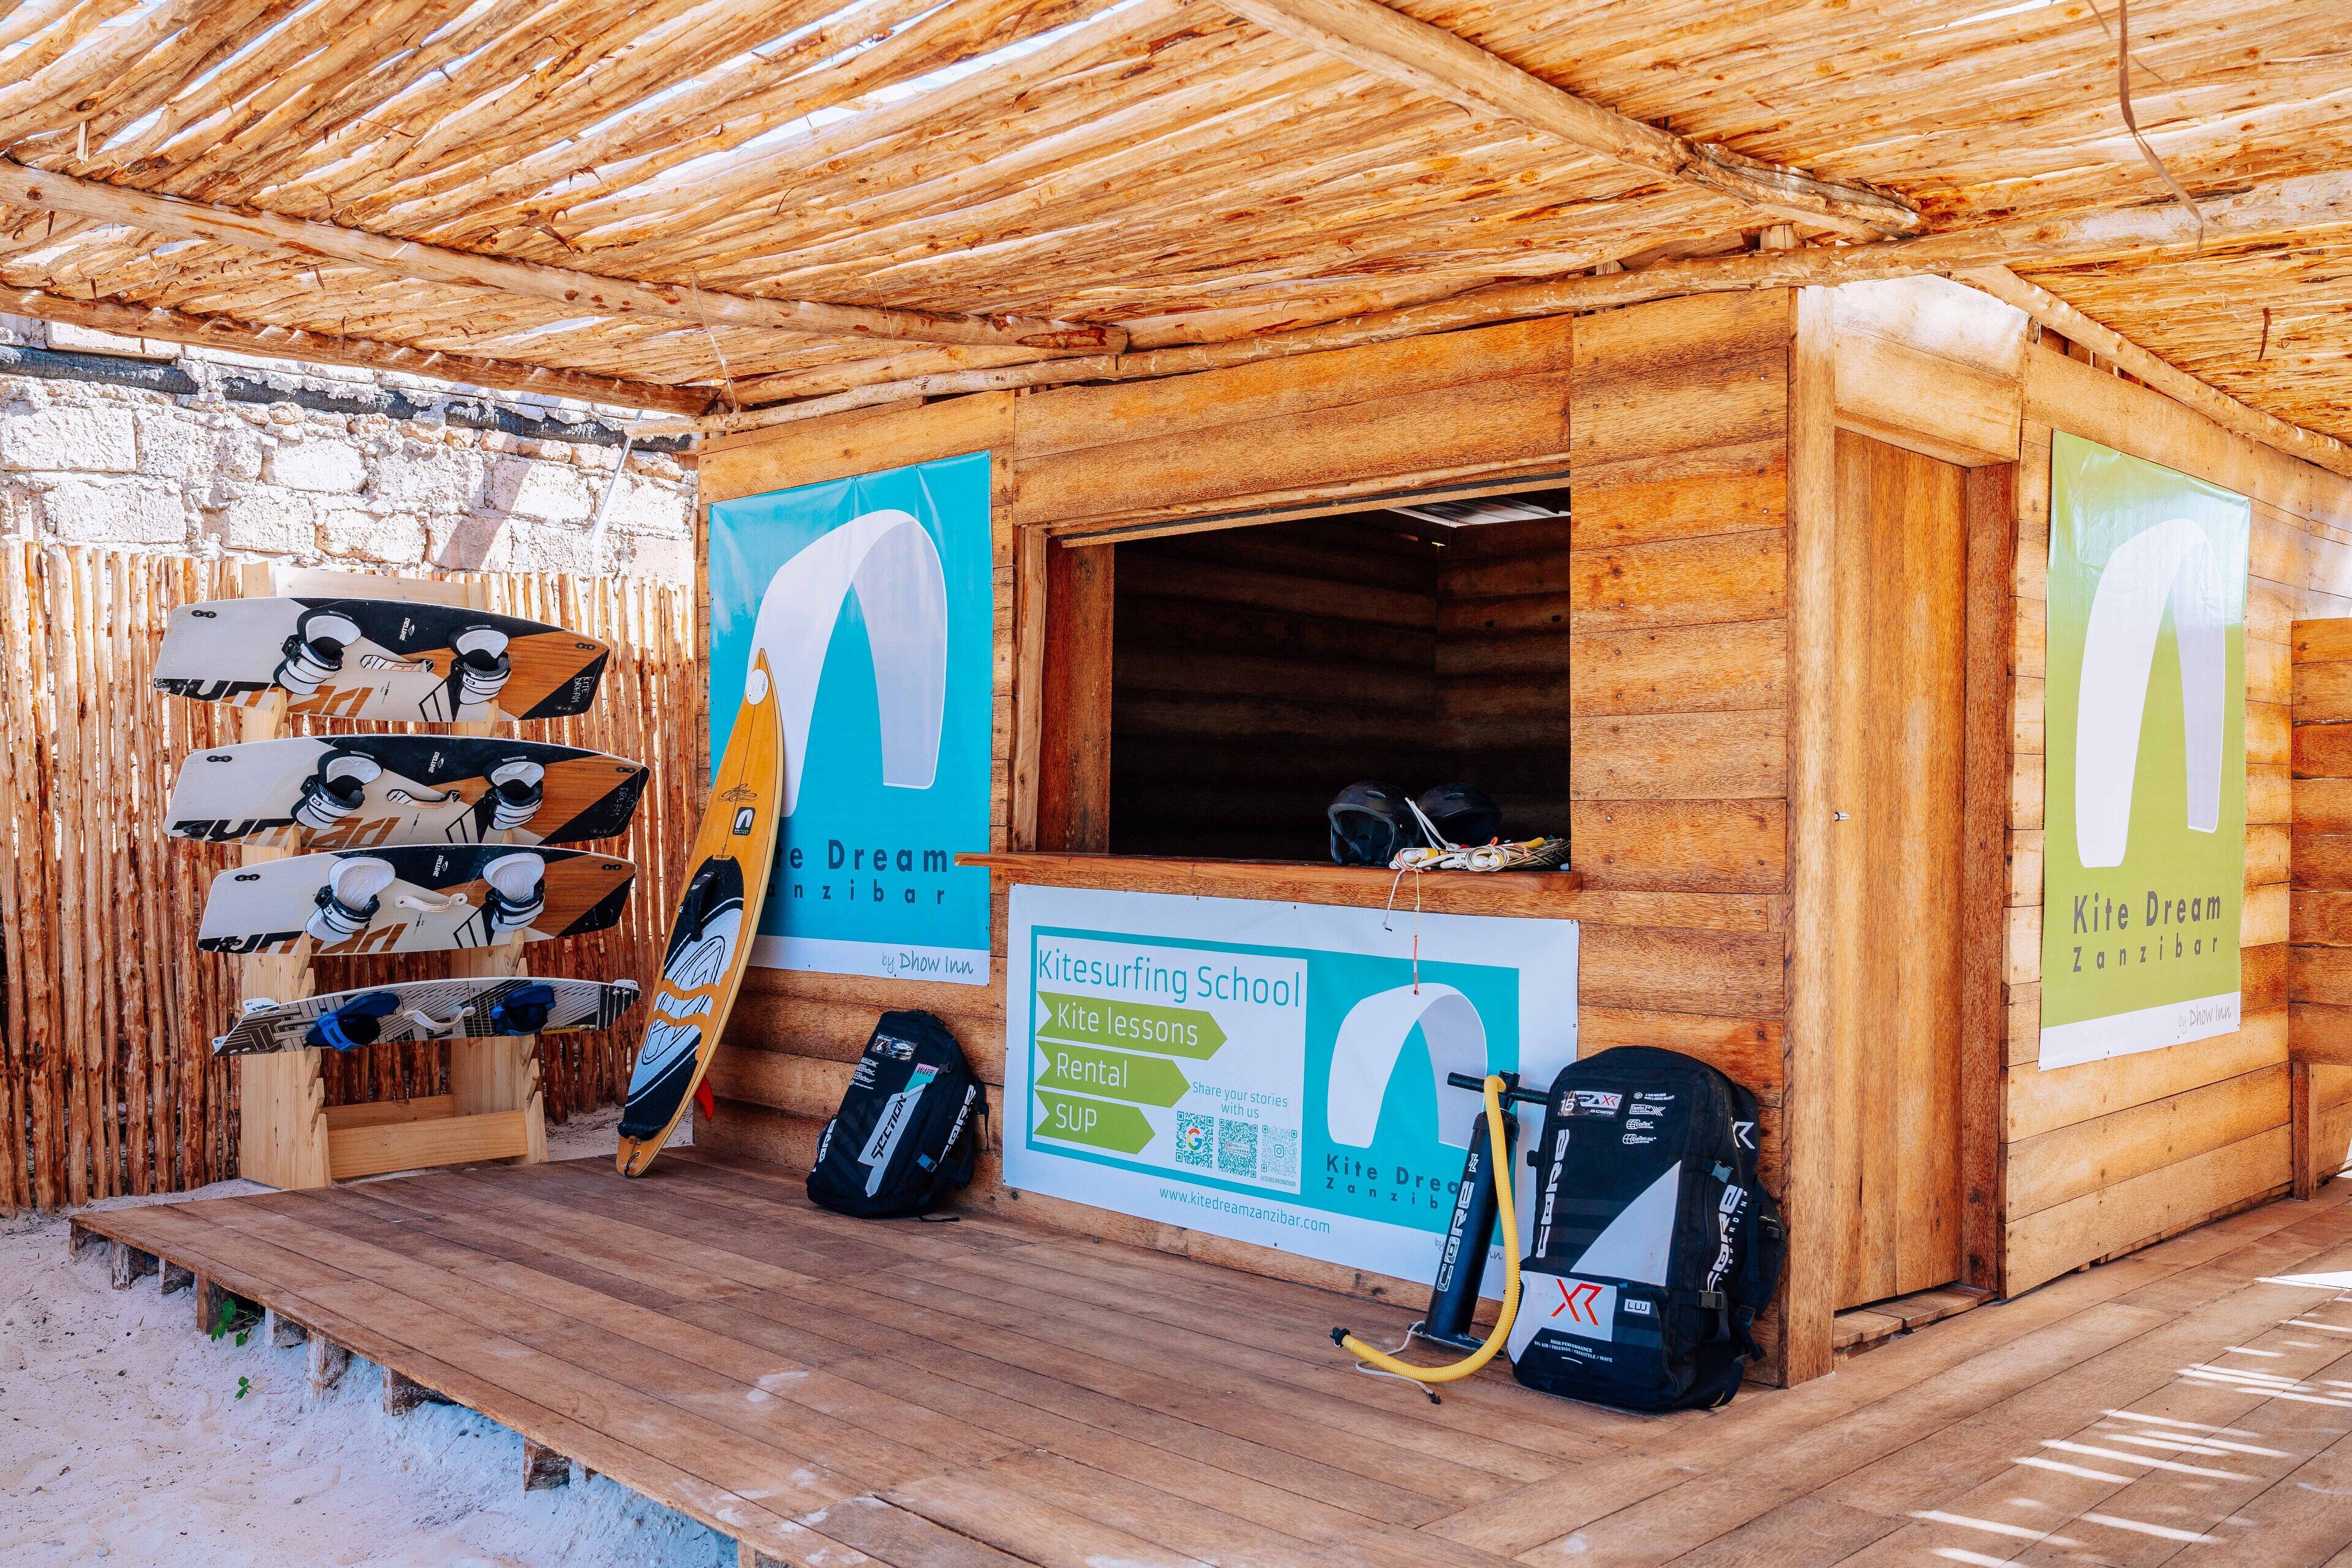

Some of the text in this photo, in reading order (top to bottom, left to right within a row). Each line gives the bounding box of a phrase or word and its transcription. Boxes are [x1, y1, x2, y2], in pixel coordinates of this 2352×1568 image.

[571, 677, 582, 703] DREAM
[582, 677, 593, 693] KITE
[774, 839, 948, 873] te Dream
[767, 878, 945, 905] anzibar
[2073, 891, 2220, 934] Kite Dream
[882, 951, 974, 974] by Dhow Inn
[2073, 933, 2217, 973] Zanzibar
[1039, 948, 1300, 1008] Kitesurfing School
[1058, 1001, 1198, 1047] Kite lessons
[2177, 1004, 2232, 1035] by Dhow Inn
[876, 1042, 884, 1050] 6
[917, 1066, 935, 1077] WAVE
[1057, 1052, 1128, 1088] Rental
[1193, 1082, 1288, 1108] Share your stories
[1221, 1102, 1259, 1118] with us
[1561, 1098, 1576, 1112] 15
[1600, 1095, 1619, 1106] XR
[870, 1094, 907, 1159] SECTION
[1055, 1103, 1098, 1133] SUP
[1261, 1175, 1297, 1187] KITEDREAMZANZIBAR
[1326, 1153, 1460, 1194] Kite Drea
[1326, 1177, 1438, 1209] Zanzib
[1536, 1129, 1570, 1259] CORE
[1159, 1187, 1330, 1234] www.kitedreamzanzibar.com
[1437, 1180, 1475, 1292] CORE
[1707, 1185, 1743, 1292] CORE
[1550, 1278, 1604, 1326] XR
[1561, 1341, 1593, 1353] PERFORMANCE
[1574, 1349, 1596, 1359] FREESTYLE
